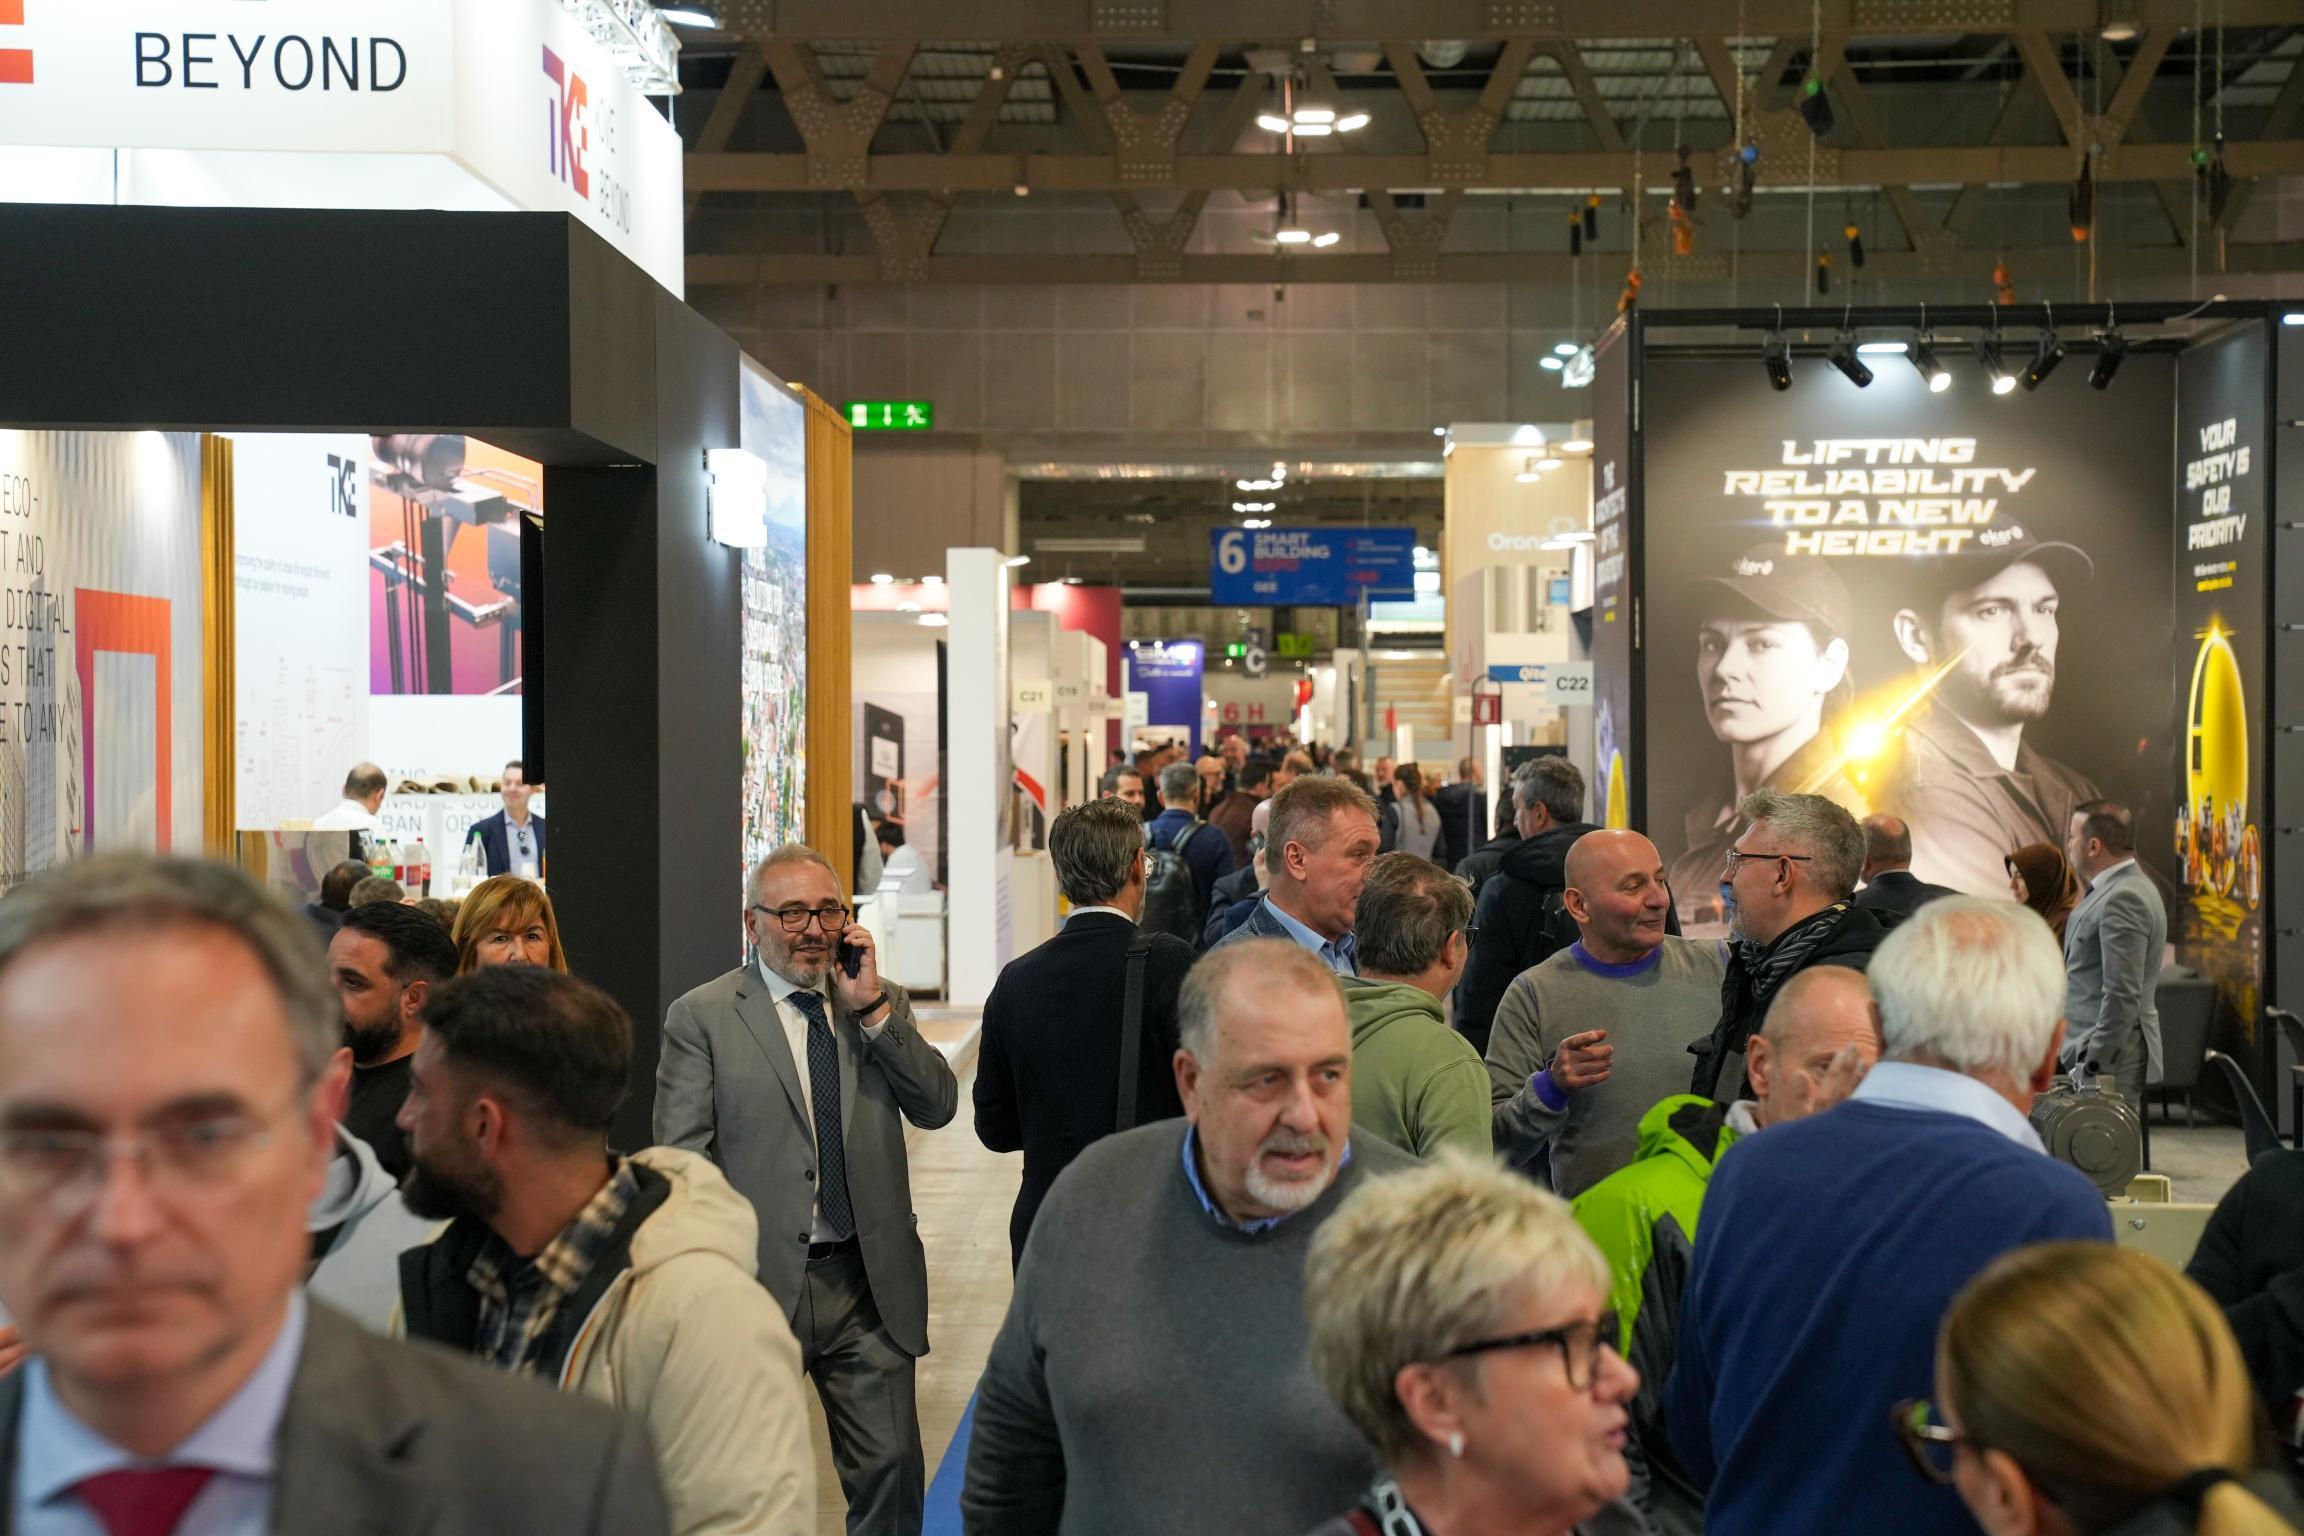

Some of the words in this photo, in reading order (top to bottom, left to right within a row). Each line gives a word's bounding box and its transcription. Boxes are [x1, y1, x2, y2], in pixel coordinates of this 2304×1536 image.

[134, 32, 407, 91] BEYOND
[1782, 438, 1977, 464] LIFTING
[2200, 418, 2236, 452] YOUR
[1723, 468, 2037, 495] RELIABILITY
[2186, 452, 2236, 489] SAFETY
[2236, 446, 2250, 476] IS
[2, 473, 39, 518] ECO-
[1763, 500, 1832, 526] TO
[1831, 500, 1869, 524] A
[1878, 499, 1999, 524] NEW
[2202, 485, 2231, 516] OUR
[1254, 533, 1310, 545] SMART
[1785, 530, 1974, 555] HEIGHT
[2188, 513, 2247, 551] PRIORITY
[16, 533, 44, 576] AND
[1218, 531, 1247, 574] 6
[1253, 545, 1330, 559] BUILDING
[6, 588, 70, 634] DIGITAL
[17, 646, 53, 687] THAT
[1020, 691, 1043, 702] C21
[1556, 677, 1589, 691] C22
[15, 702, 33, 743] TO
[39, 703, 66, 742] ANY
